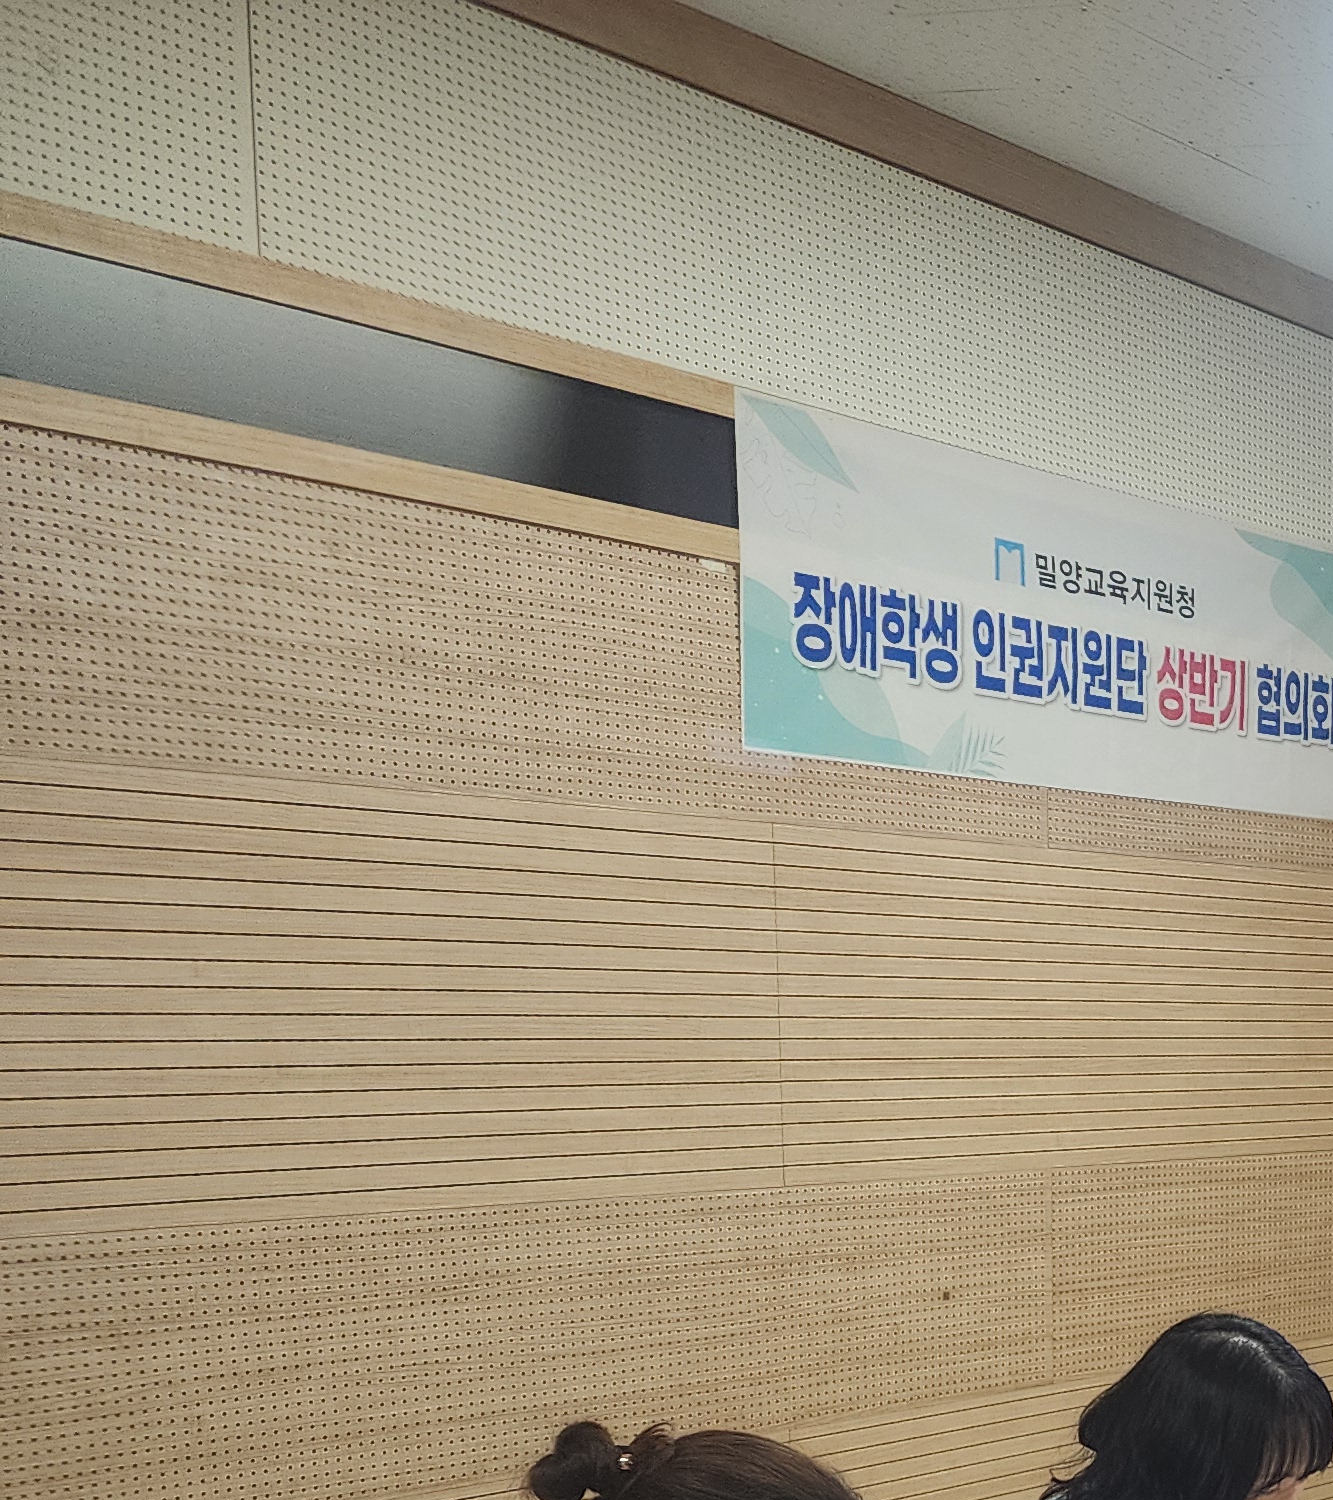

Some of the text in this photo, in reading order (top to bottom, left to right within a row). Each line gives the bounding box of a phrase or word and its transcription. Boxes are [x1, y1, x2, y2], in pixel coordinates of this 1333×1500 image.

[1034, 551, 1197, 618] 밀양교육지원청
[793, 571, 959, 682] 장애학생
[972, 607, 1148, 715] 인권지원단
[1156, 644, 1247, 731] 상반기
